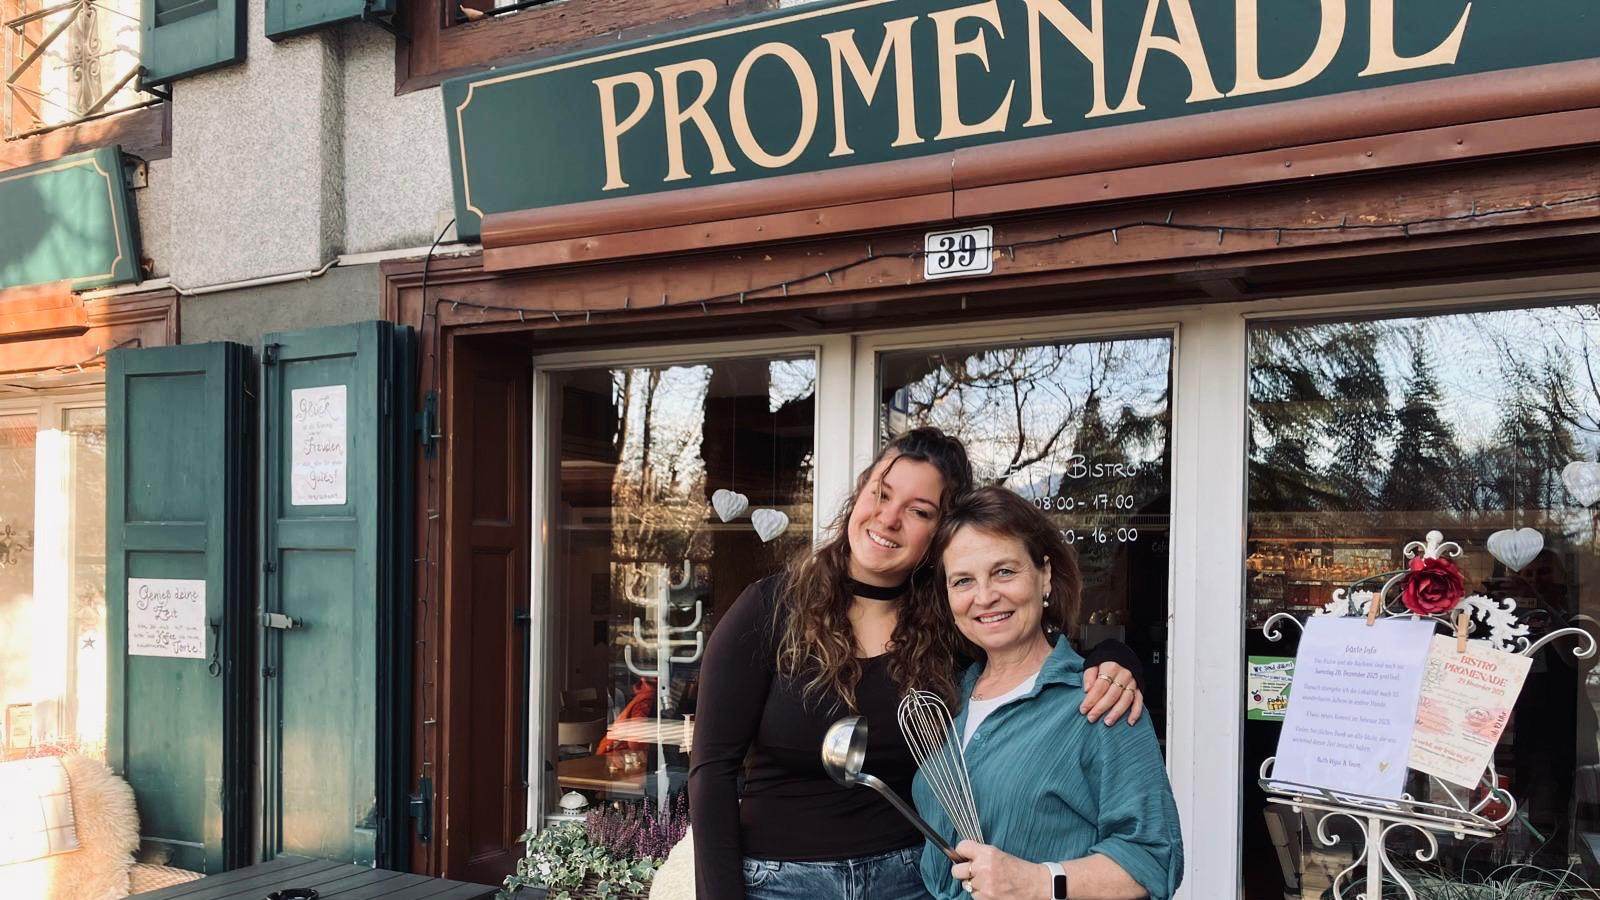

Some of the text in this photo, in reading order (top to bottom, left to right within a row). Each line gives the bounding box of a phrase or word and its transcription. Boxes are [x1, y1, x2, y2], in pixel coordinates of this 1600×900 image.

[938, 234, 977, 269] 39
[1092, 494, 1134, 510] 17:00
[1092, 527, 1138, 544] 16:00
[1460, 655, 1498, 672] BISTRO
[1444, 662, 1508, 688] PROMENADE
